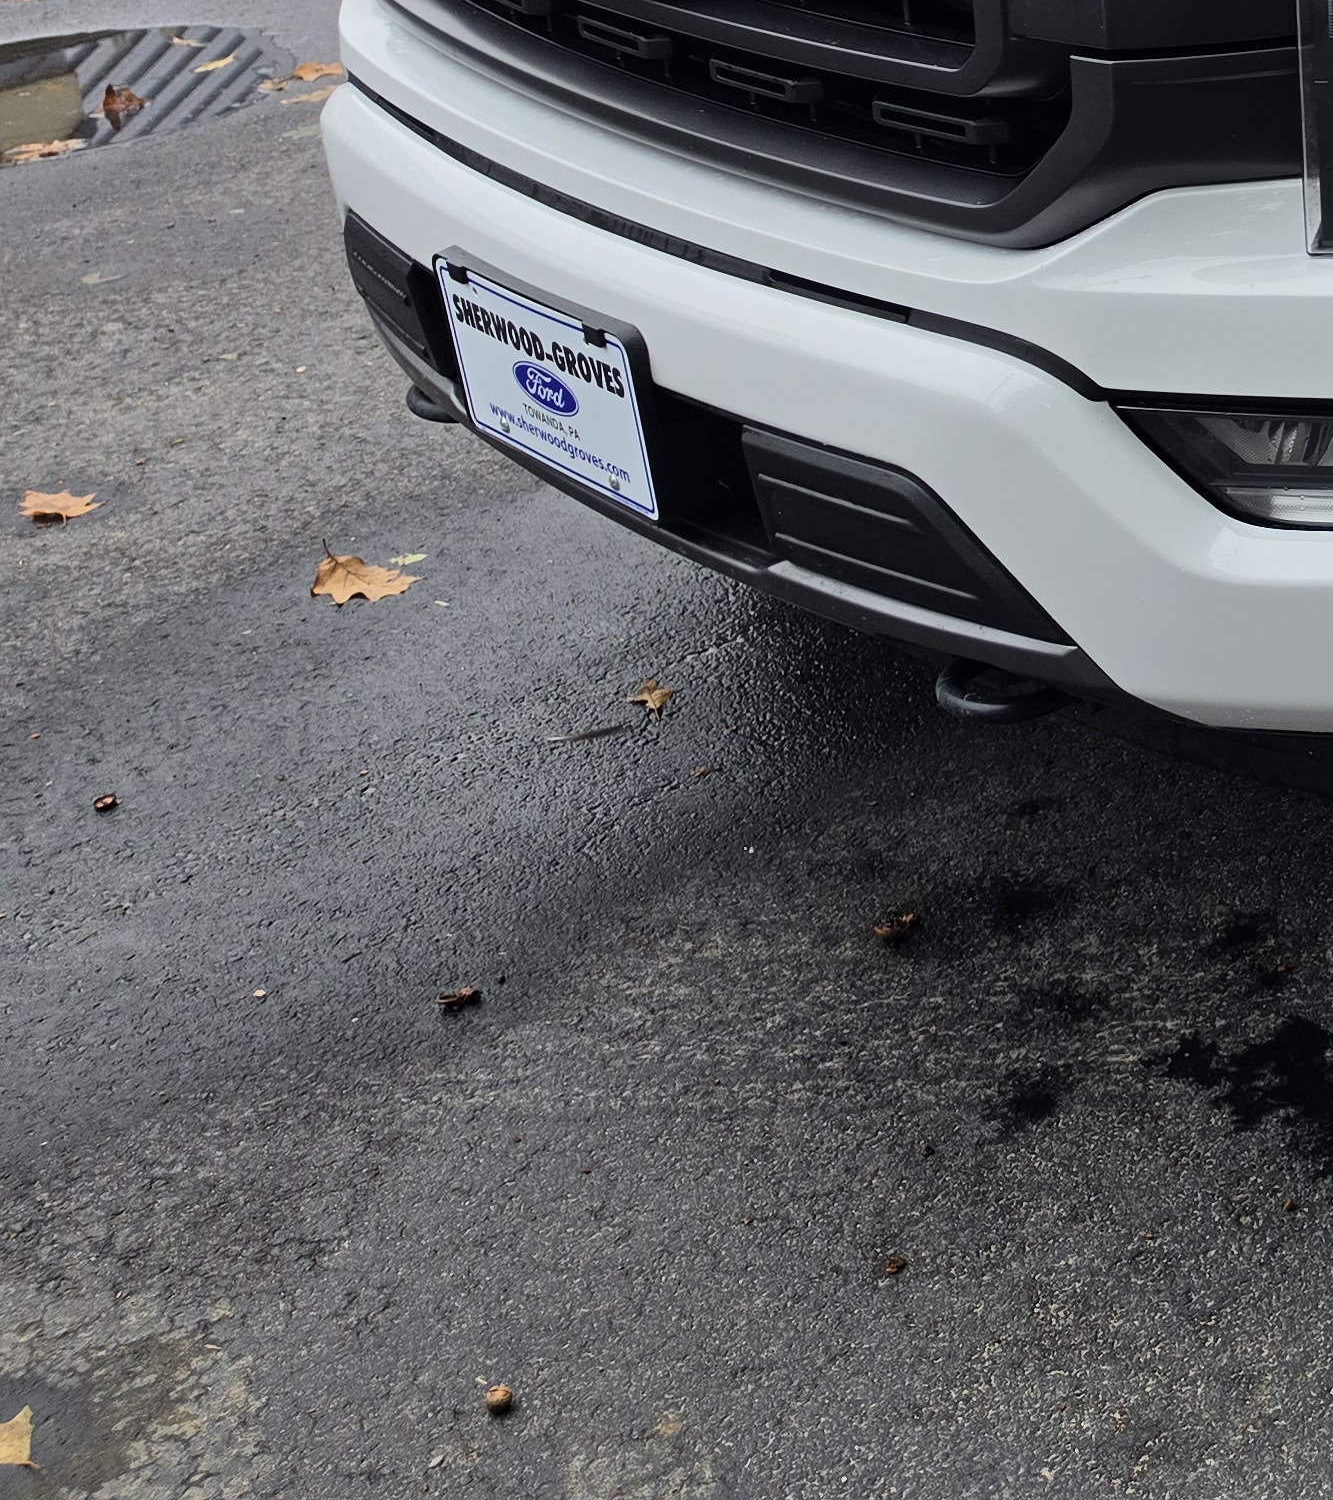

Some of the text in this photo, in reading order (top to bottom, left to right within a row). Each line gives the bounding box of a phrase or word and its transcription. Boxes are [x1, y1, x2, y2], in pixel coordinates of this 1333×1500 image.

[451, 292, 626, 399] SHERWOOD-GROVES
[525, 366, 566, 409] Ford
[489, 401, 632, 484] www.sherwoodgroves.com
[522, 402, 582, 442] TOWANDA, PA
